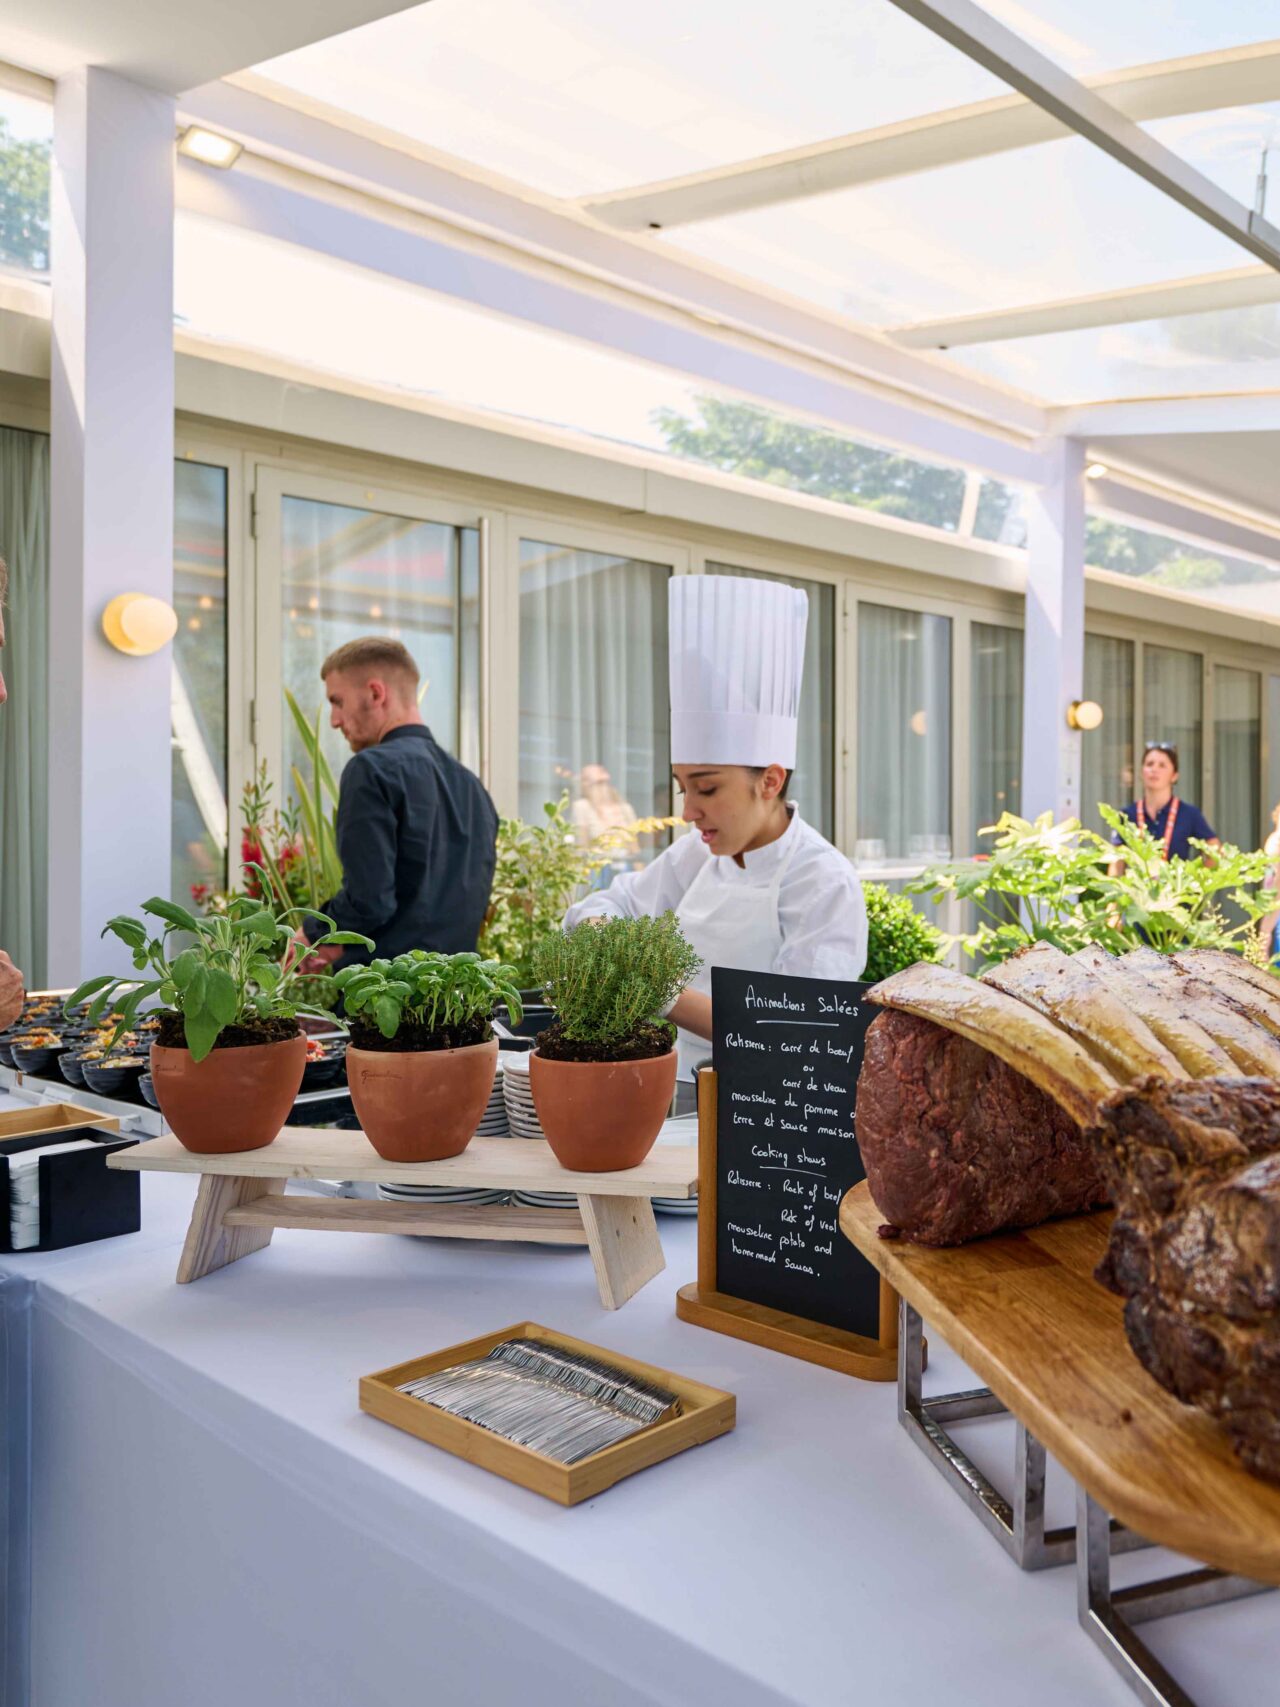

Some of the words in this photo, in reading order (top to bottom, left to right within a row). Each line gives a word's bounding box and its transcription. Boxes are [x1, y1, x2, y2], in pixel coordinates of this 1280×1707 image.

[745, 984, 805, 1012] Animations
[818, 994, 859, 1017] Salées
[809, 1039, 820, 1054] de
[806, 1076, 818, 1091] de
[731, 1090, 777, 1105] mousseline
[804, 1103, 839, 1120] pomme
[733, 1111, 755, 1126] terre
[763, 1112, 775, 1127] et
[817, 1126, 855, 1139] maison
[751, 1143, 788, 1168] Cooking
[797, 1147, 826, 1167] shows
[783, 1179, 804, 1195] Rack
[808, 1183, 818, 1203] of
[823, 1186, 842, 1205] beef
[804, 1214, 815, 1232] of
[727, 1221, 773, 1241] mousseline
[779, 1231, 806, 1251] potato
[814, 1240, 832, 1256] and
